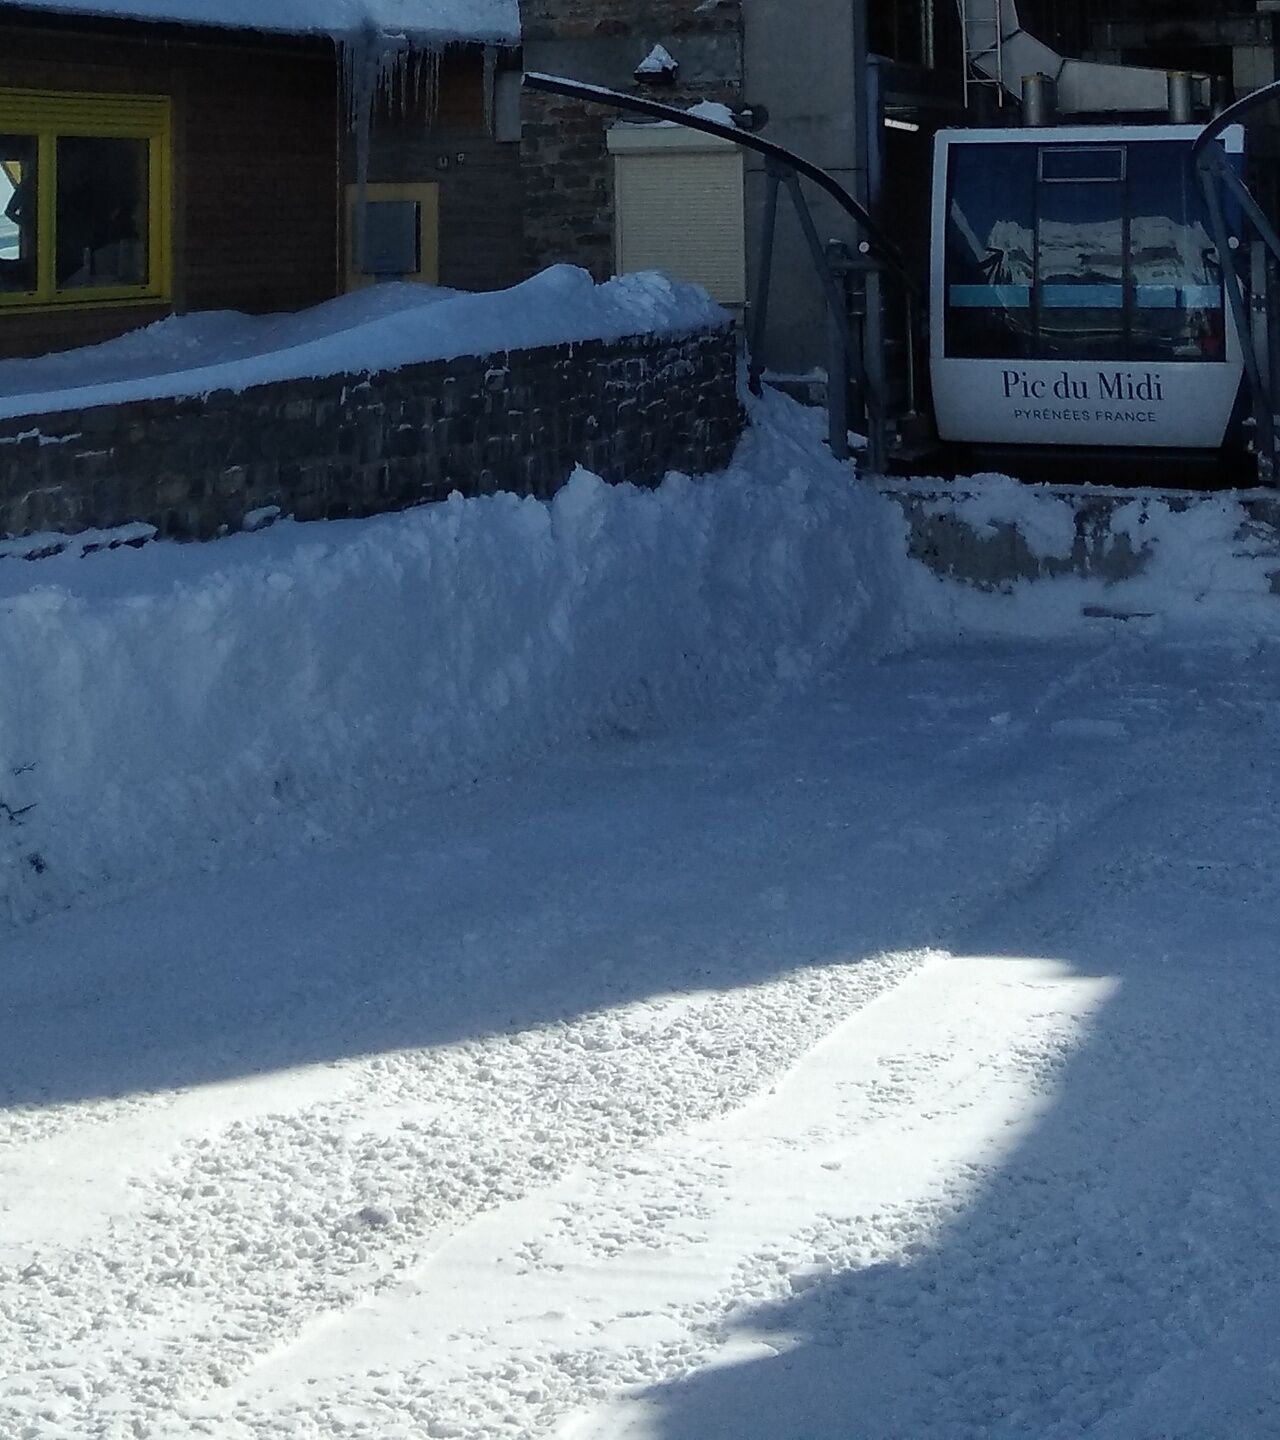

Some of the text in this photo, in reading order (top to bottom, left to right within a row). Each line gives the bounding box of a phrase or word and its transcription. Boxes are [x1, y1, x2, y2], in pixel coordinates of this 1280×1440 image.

[1001, 370, 1164, 402] Pic du Midi
[1014, 408, 1157, 423] PYRÉNÉES FRANCE
